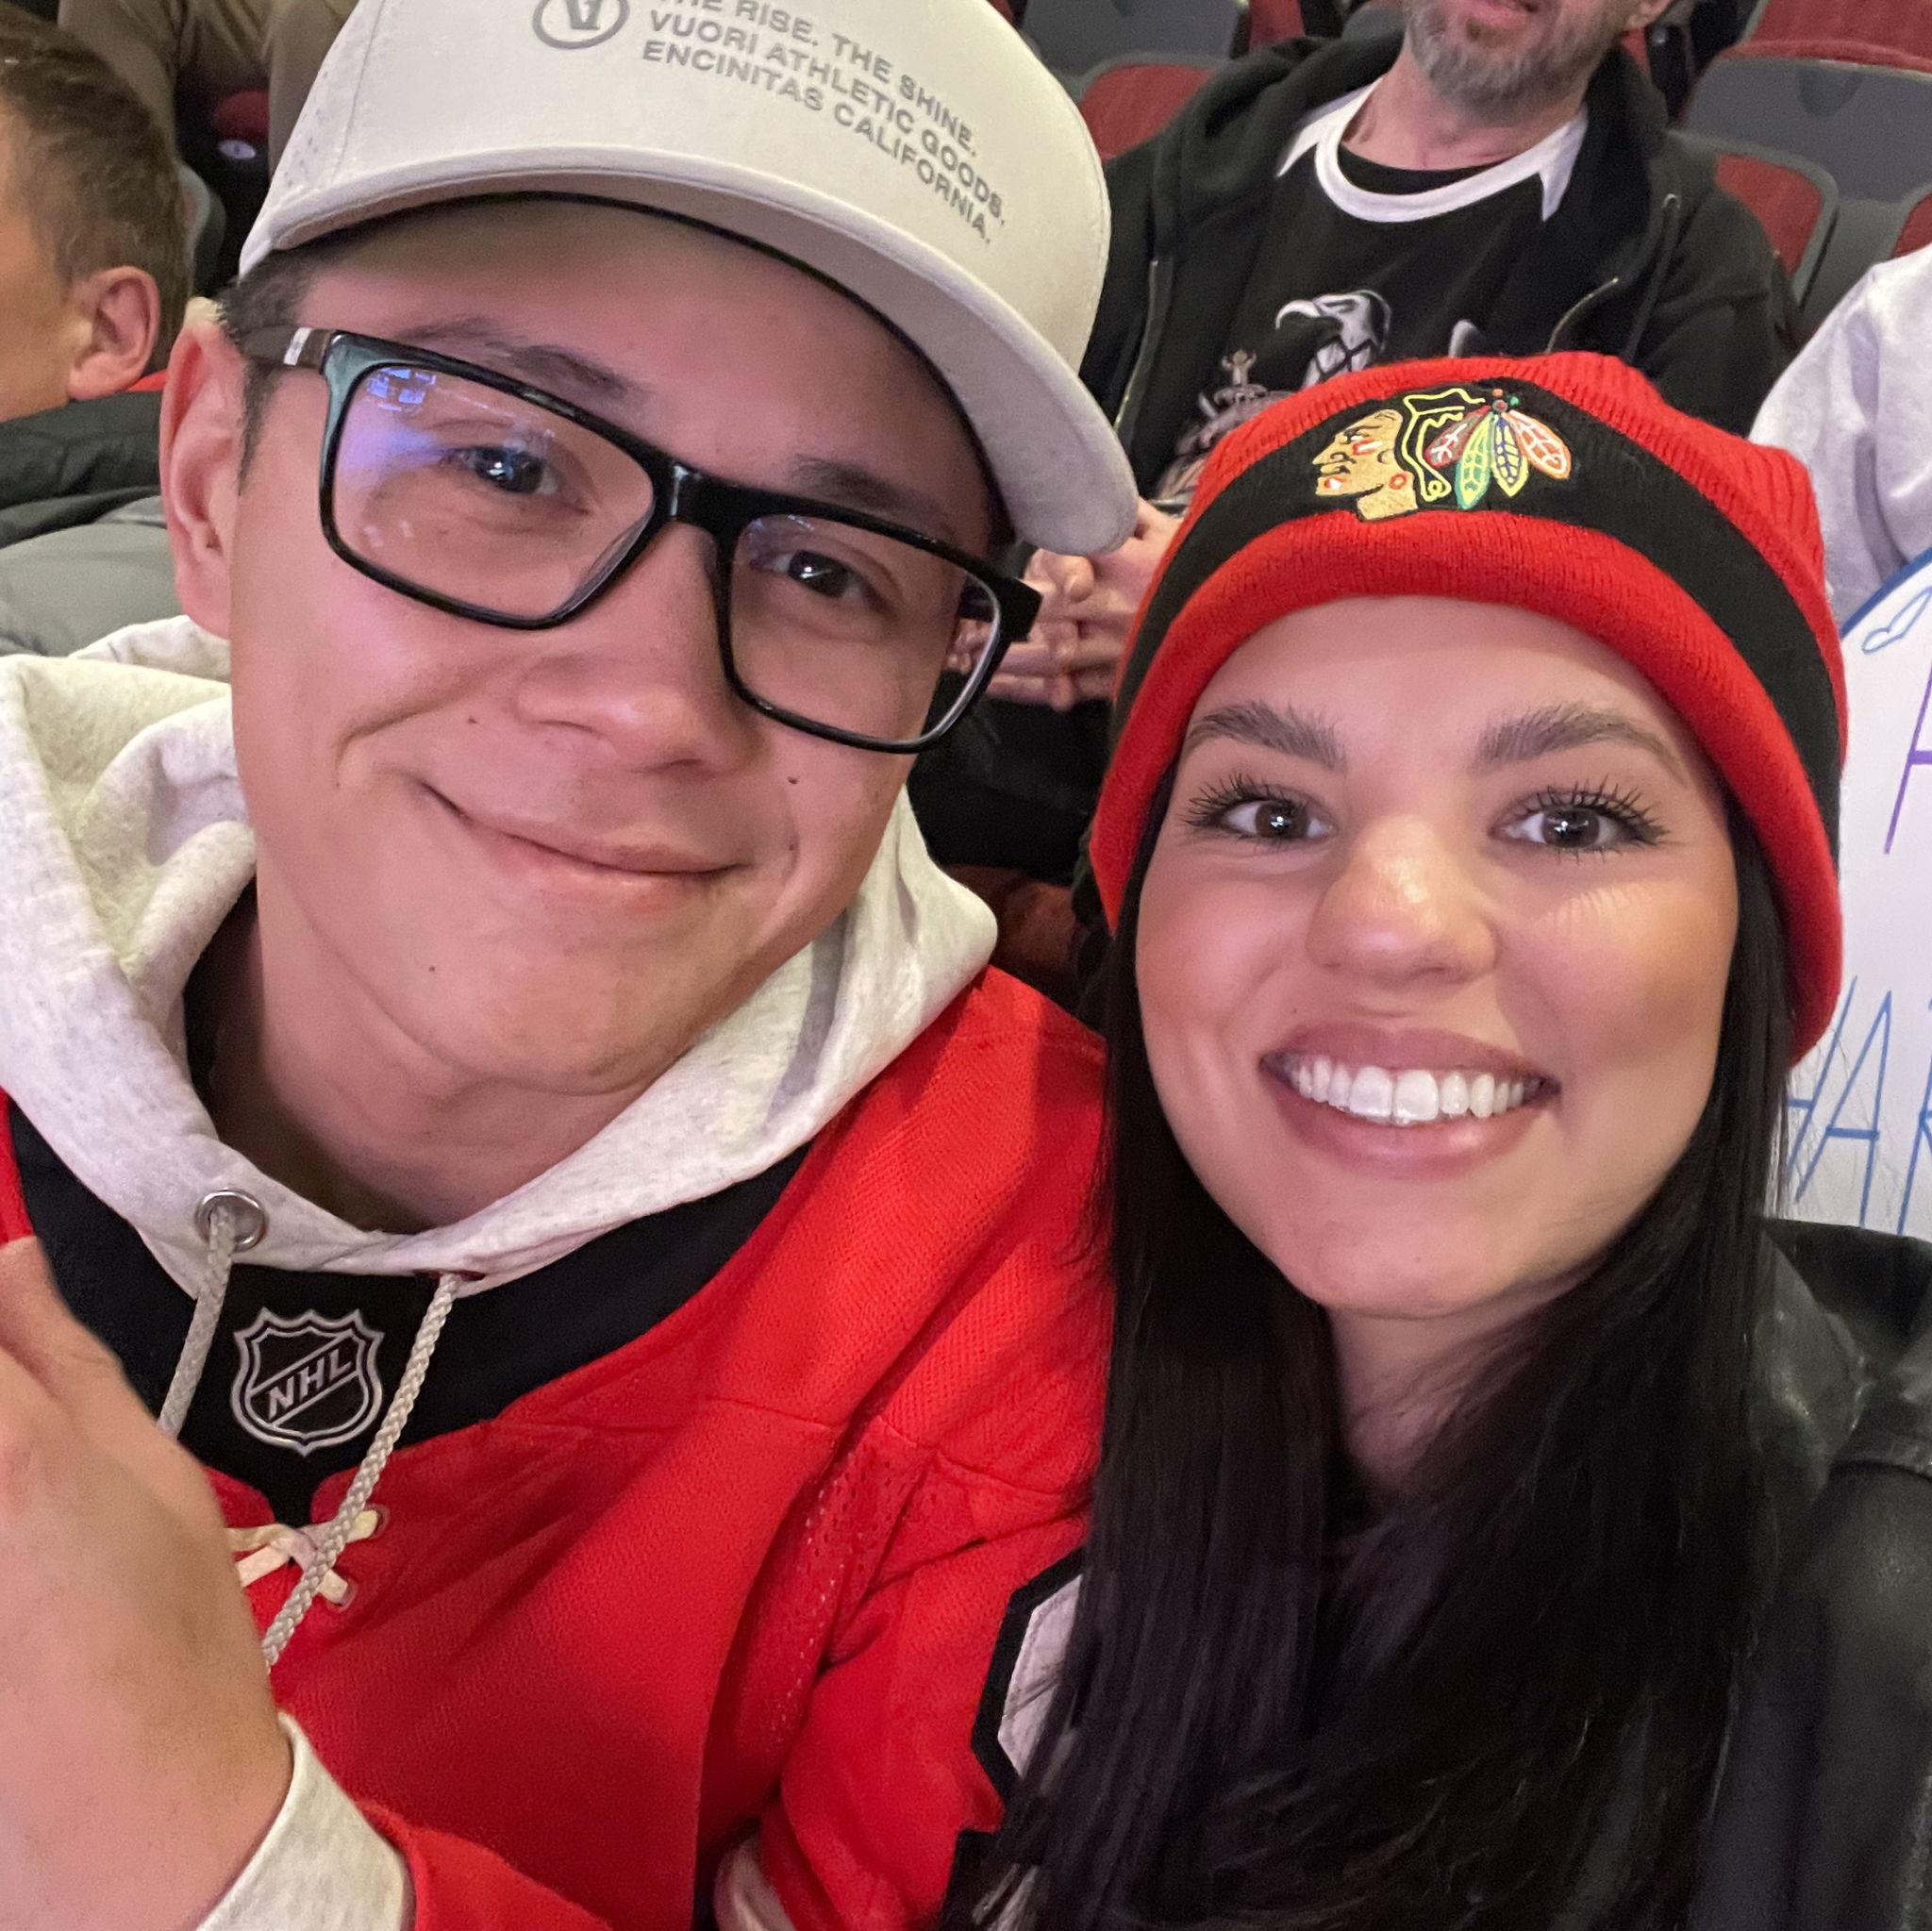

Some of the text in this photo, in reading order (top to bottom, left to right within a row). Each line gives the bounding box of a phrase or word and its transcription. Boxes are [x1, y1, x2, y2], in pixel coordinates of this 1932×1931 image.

[642, 40, 991, 245] ENCINITAS CALIFORNIA.
[650, 9, 1006, 226] VUORI ATHLETIC GOODS.
[735, 0, 977, 158] RISE. THE SHINE.
[266, 1347, 353, 1422] NHL
